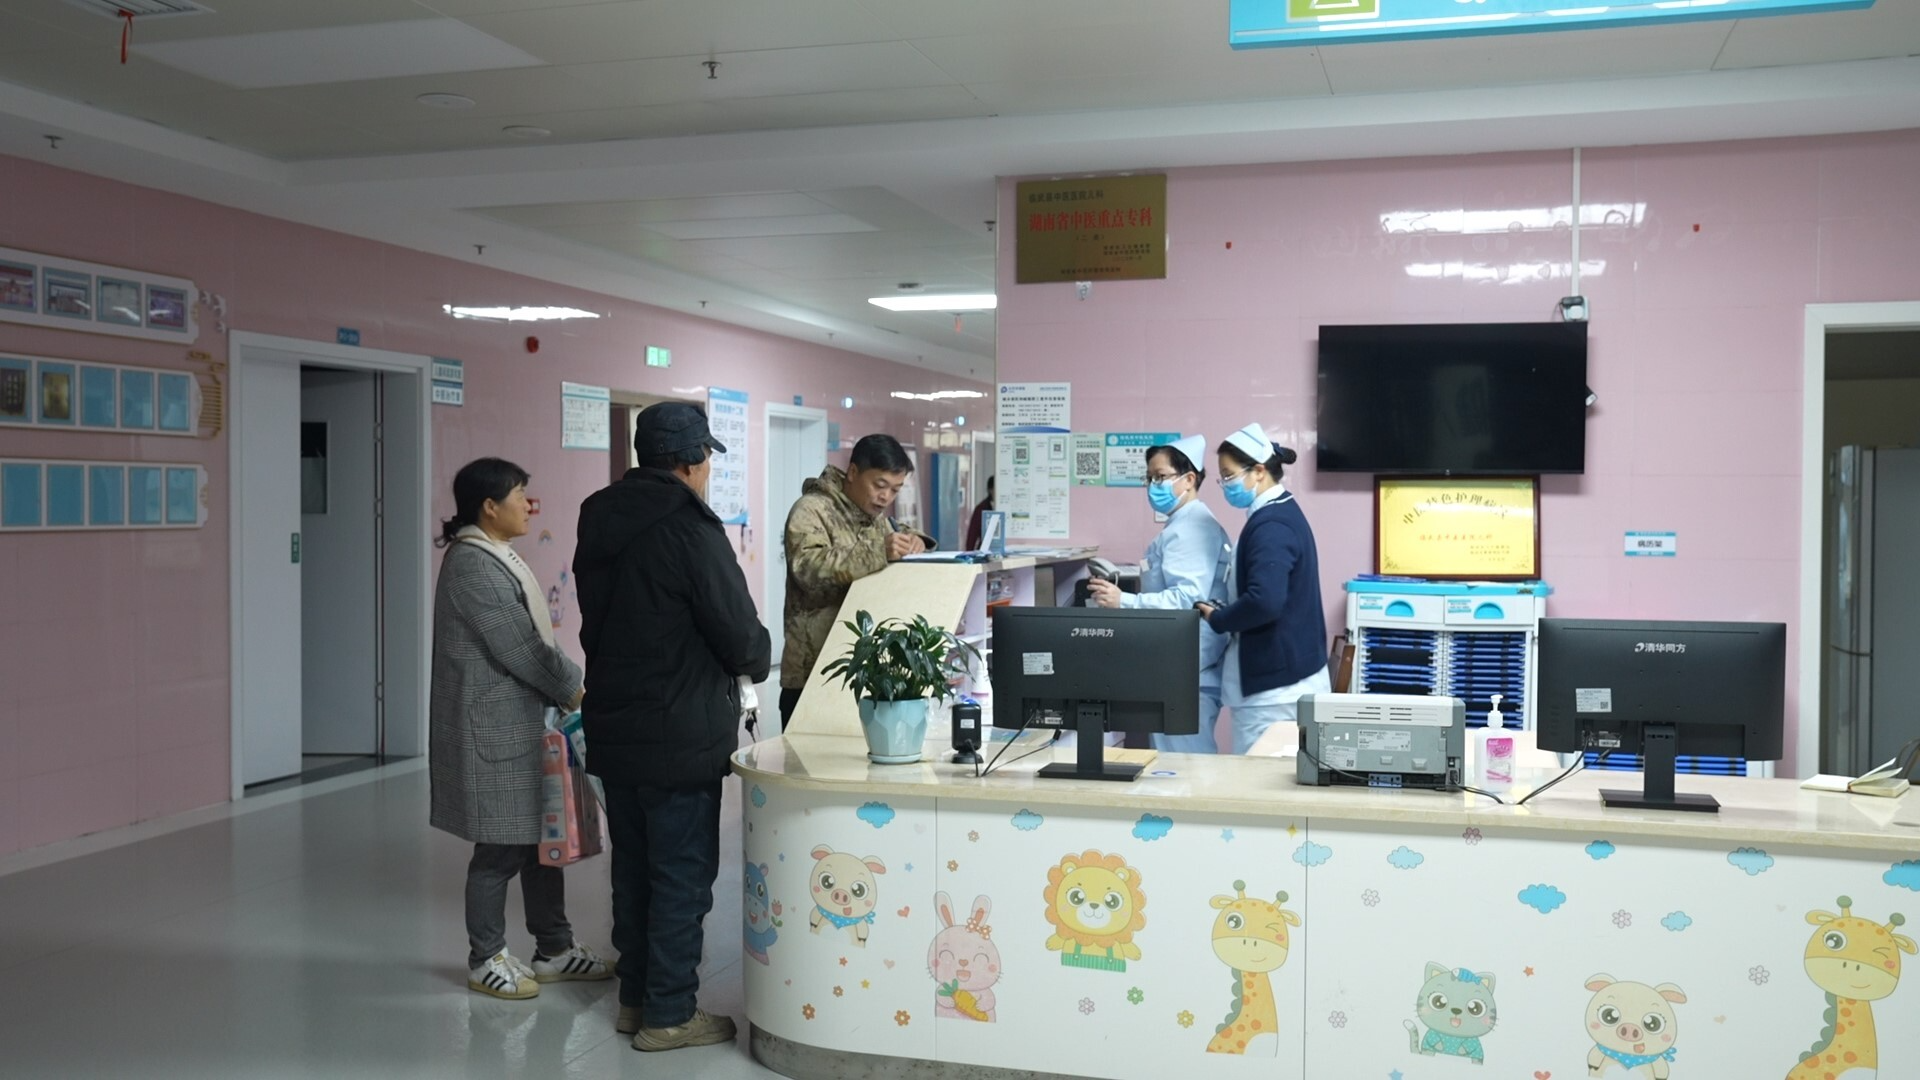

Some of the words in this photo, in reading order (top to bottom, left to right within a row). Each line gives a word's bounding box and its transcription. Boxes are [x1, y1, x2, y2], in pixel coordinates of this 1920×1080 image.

[1079, 627, 1115, 638] 清华同方
[1644, 642, 1686, 654] 清华同方
